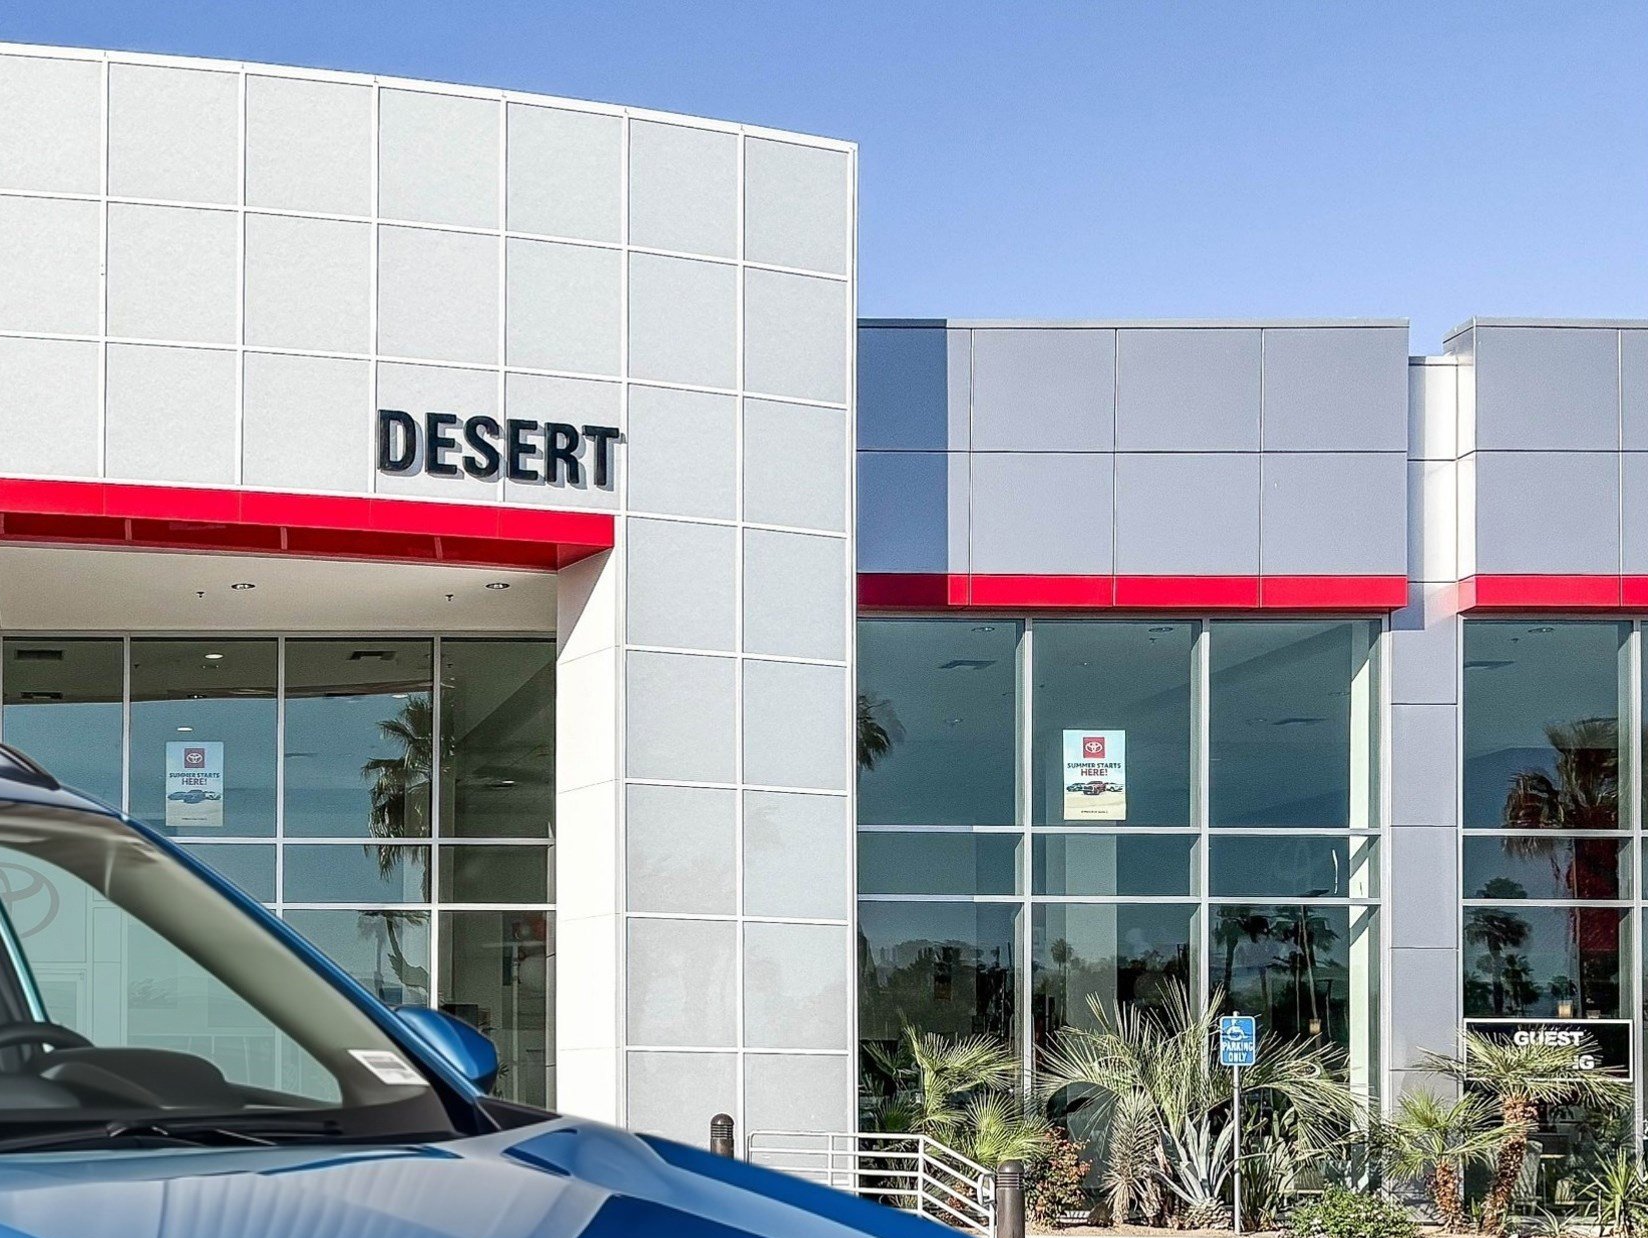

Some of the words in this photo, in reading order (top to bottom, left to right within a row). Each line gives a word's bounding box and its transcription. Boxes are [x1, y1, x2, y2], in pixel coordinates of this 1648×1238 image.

[377, 409, 620, 486] DESERT
[1080, 768, 1108, 776] HERE!
[181, 778, 207, 786] HERE!
[1513, 1030, 1584, 1047] GUEST
[1222, 1041, 1253, 1051] PARKING
[1228, 1051, 1248, 1062] ONLY
